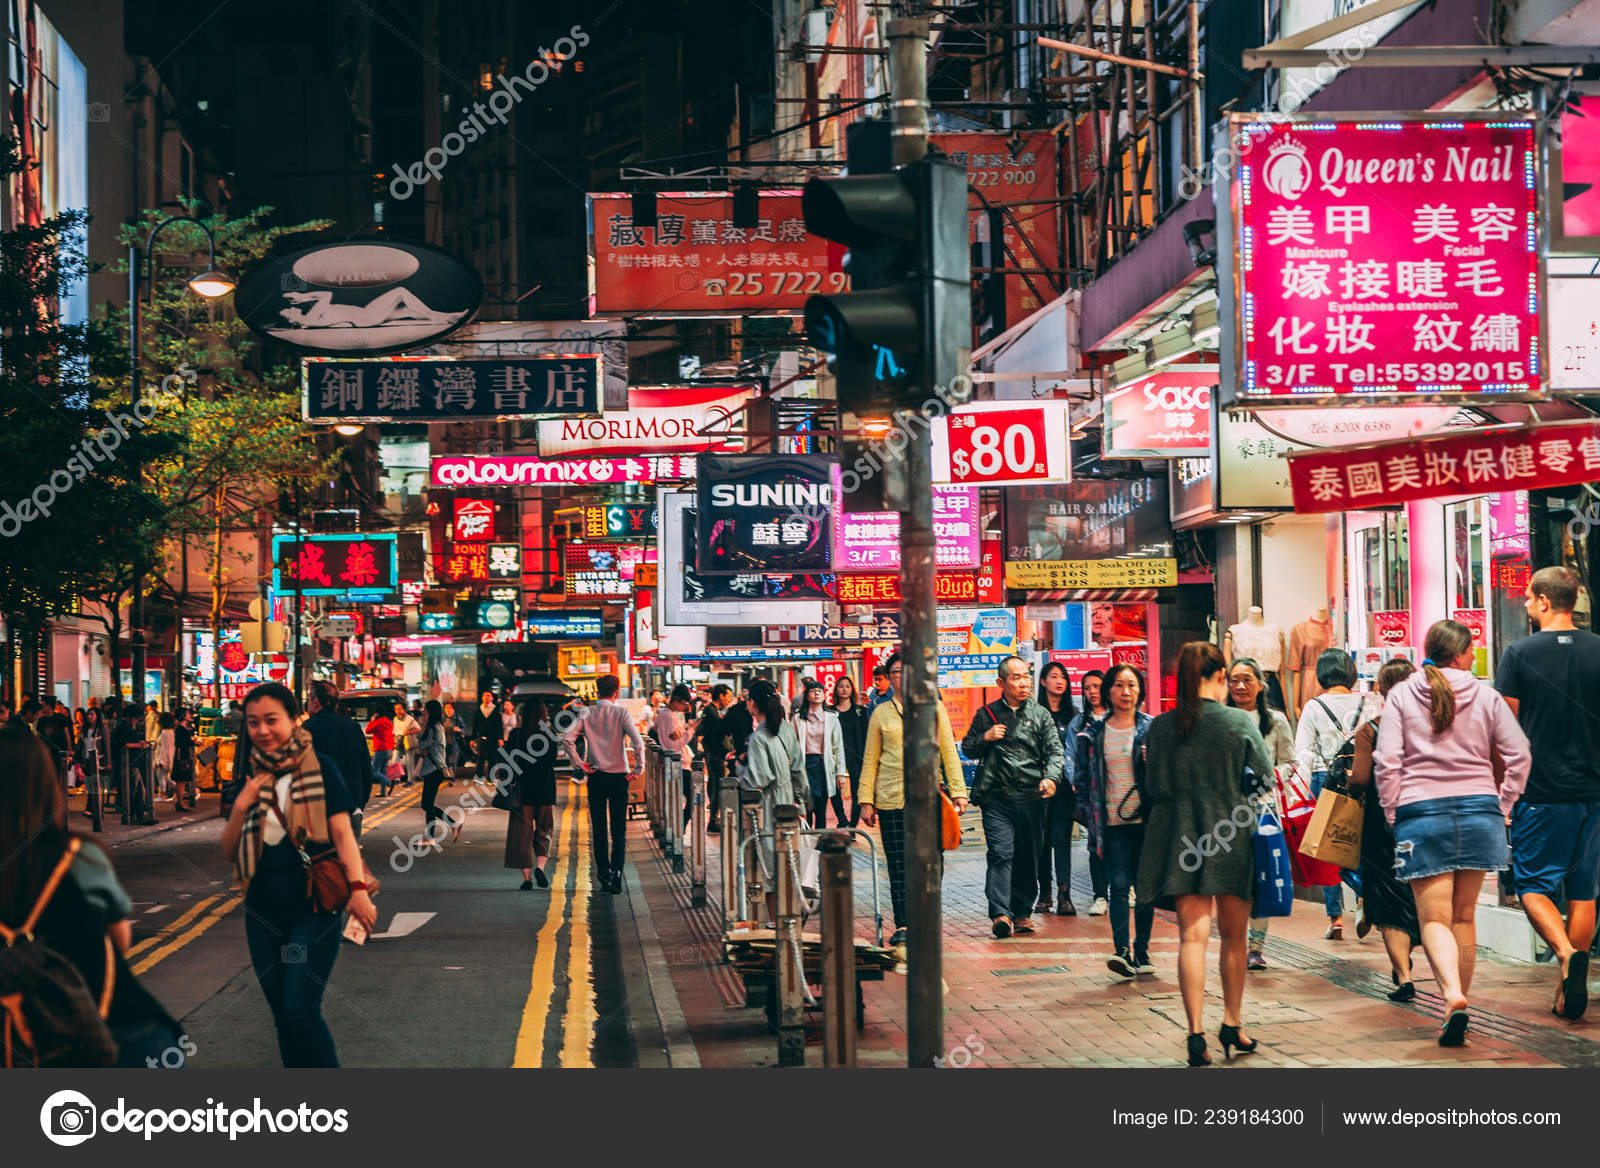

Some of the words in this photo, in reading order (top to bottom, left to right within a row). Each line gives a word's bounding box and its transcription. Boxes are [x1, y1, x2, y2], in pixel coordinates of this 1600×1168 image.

[1003, 170, 1036, 185] 900
[1320, 147, 1435, 197] Queen's
[1443, 146, 1513, 183] Nail
[1266, 204, 1372, 246] 美甲
[1411, 203, 1518, 245] 美容
[1285, 247, 1349, 260] Manicure
[1443, 244, 1485, 258] Facial
[729, 272, 765, 296] 25
[770, 271, 823, 295] 722
[1280, 259, 1505, 300] 嫁接睫毛
[1328, 301, 1395, 315] Eyelashes
[1396, 300, 1459, 312] extension
[1267, 315, 1376, 355] 化妝
[1412, 312, 1522, 353] 紋繡
[1266, 363, 1316, 385] 3/F
[1329, 362, 1525, 383] Tel:55392015
[321, 364, 588, 411] 銅鑼灣書店
[952, 423, 1036, 480] $80
[1309, 436, 1600, 502] 泰國美妝保健零售
[1049, 504, 1082, 515] HAIR
[1084, 504, 1096, 515] &
[848, 551, 881, 562] 3/F
[1037, 562, 1067, 570] Hand
[1097, 561, 1122, 569] Soak
[1148, 560, 1168, 568] Gel
[1127, 568, 1167, 577] $208
[1050, 570, 1089, 578] $168
[1127, 577, 1167, 586] $248
[1050, 579, 1089, 587] $198
